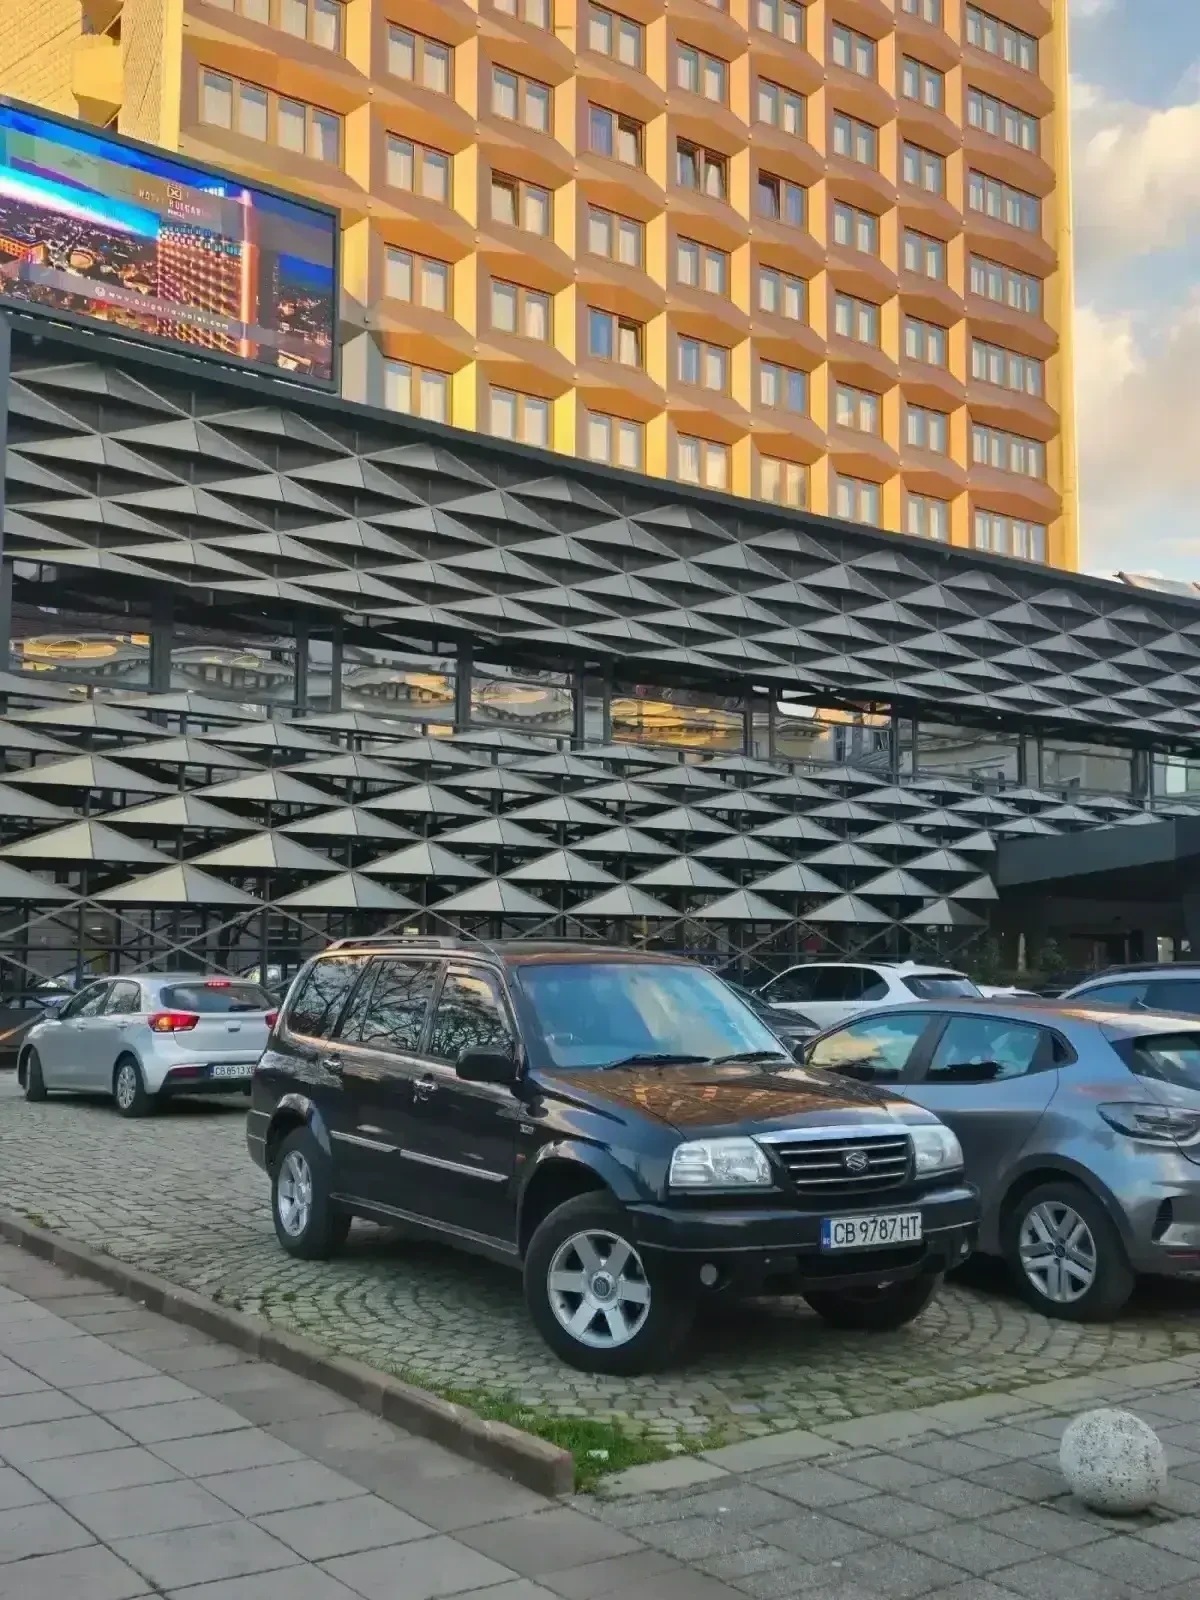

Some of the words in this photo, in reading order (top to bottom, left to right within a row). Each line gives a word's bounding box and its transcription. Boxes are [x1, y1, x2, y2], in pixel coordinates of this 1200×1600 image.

[834, 1223, 855, 1244] CB
[859, 1217, 897, 1242] 9787
[900, 1215, 918, 1238] HT
